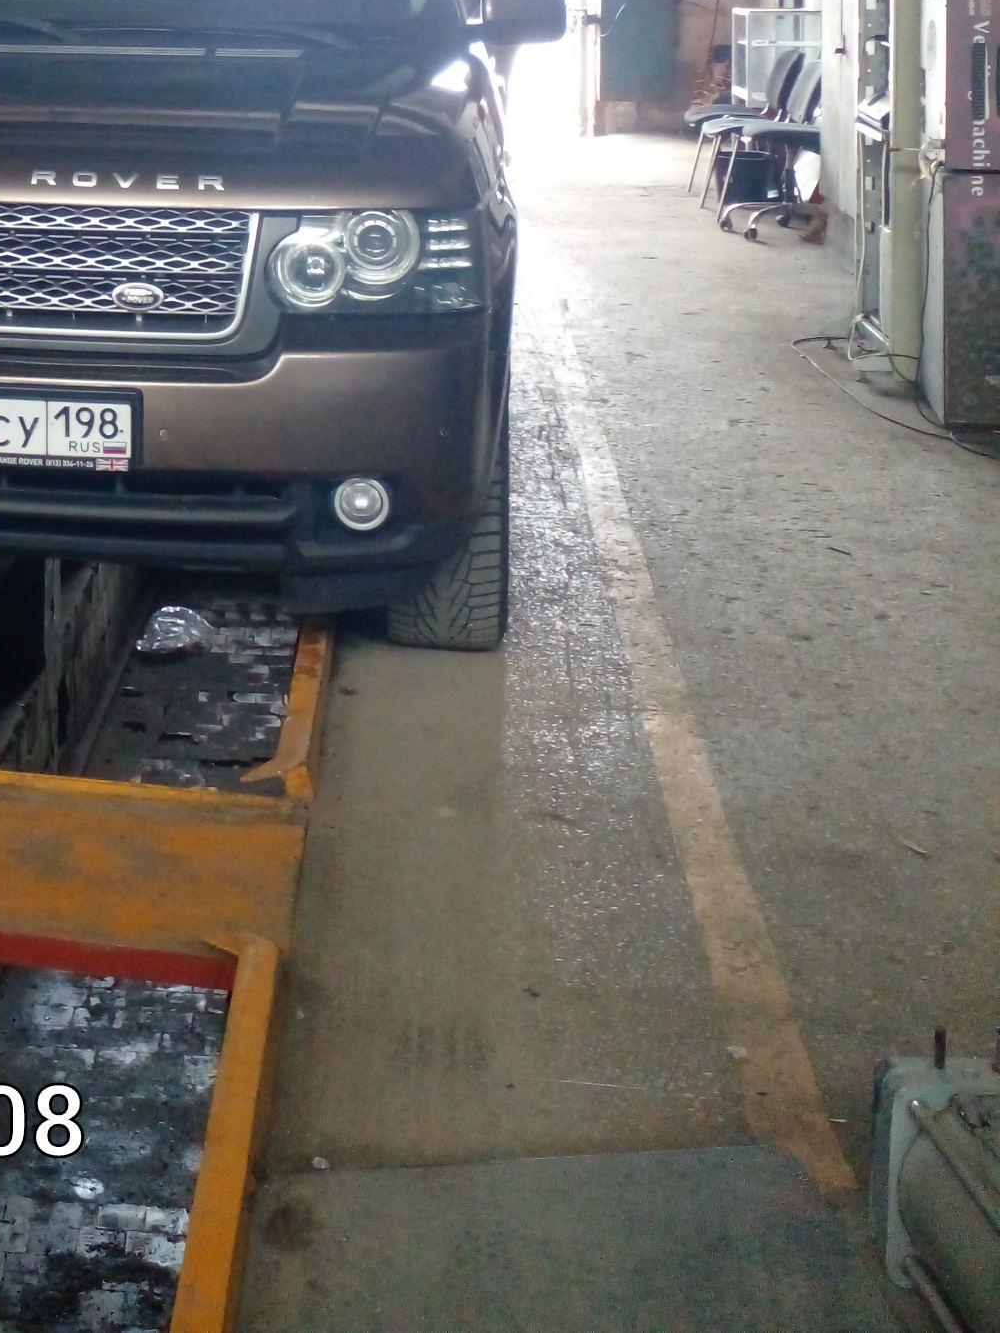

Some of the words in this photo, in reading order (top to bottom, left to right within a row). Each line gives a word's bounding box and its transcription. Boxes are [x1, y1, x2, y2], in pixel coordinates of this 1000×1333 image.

[31, 169, 225, 191] ROVER
[53, 406, 119, 440] 198
[68, 441, 101, 454] RUS
[19, 458, 43, 466] ROVER
